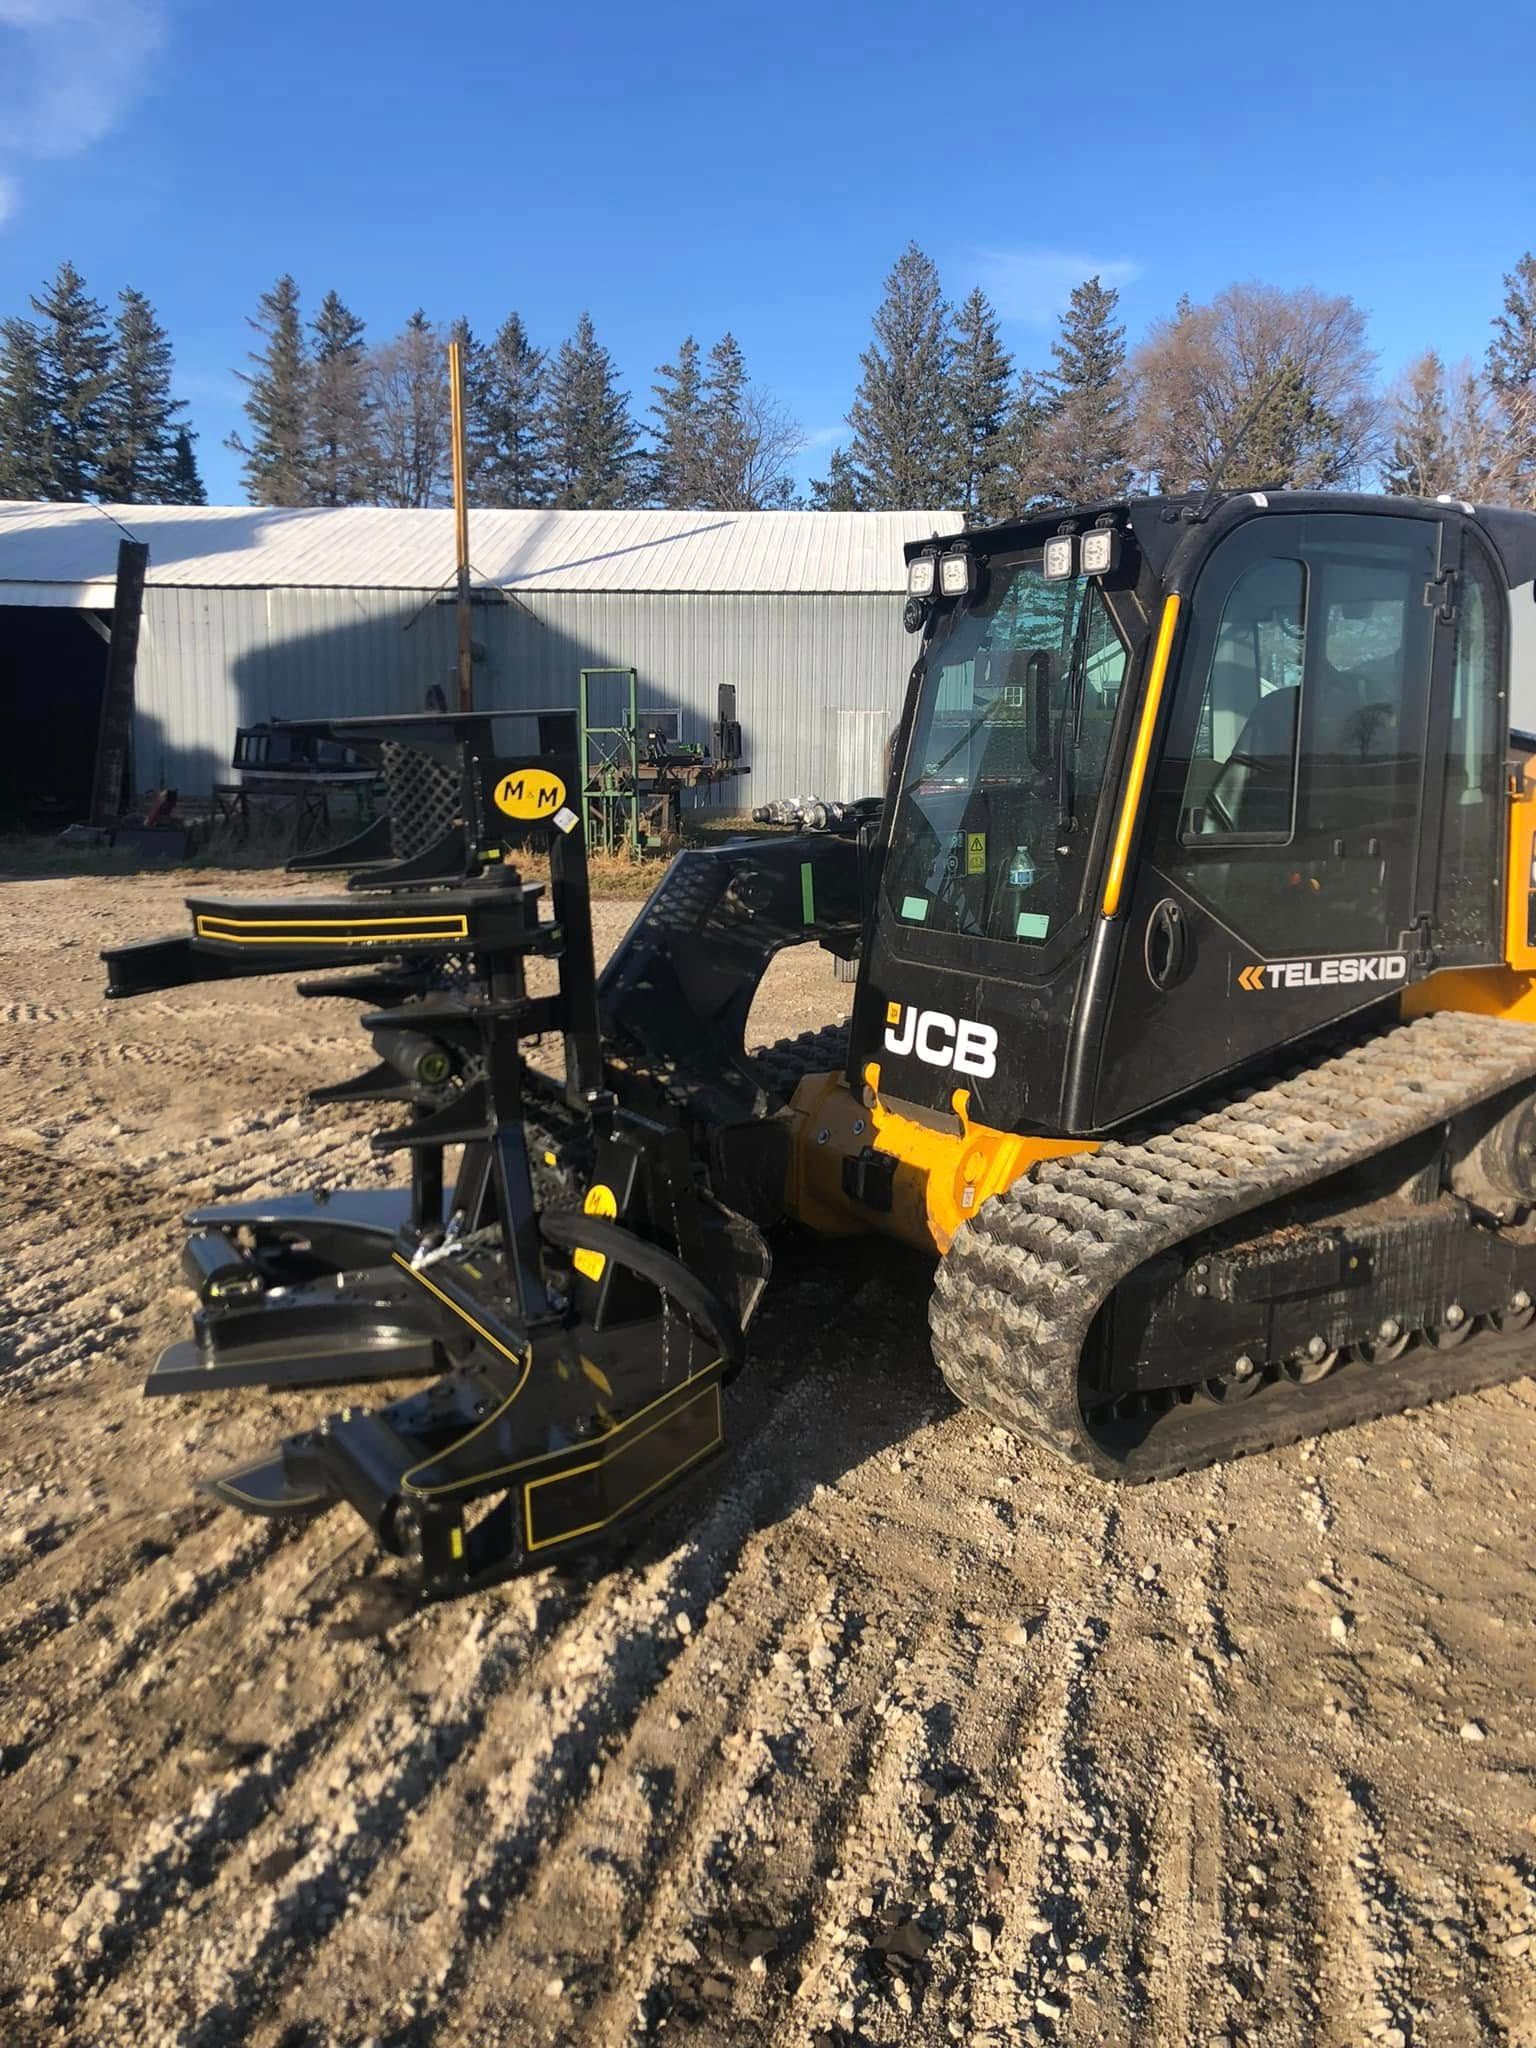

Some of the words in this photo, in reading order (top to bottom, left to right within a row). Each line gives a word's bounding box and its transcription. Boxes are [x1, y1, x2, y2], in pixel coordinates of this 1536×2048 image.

[503, 780, 524, 801] M
[537, 786, 558, 809] M
[1266, 955, 1407, 989] TELESKID
[884, 1005, 999, 1080] JCB
